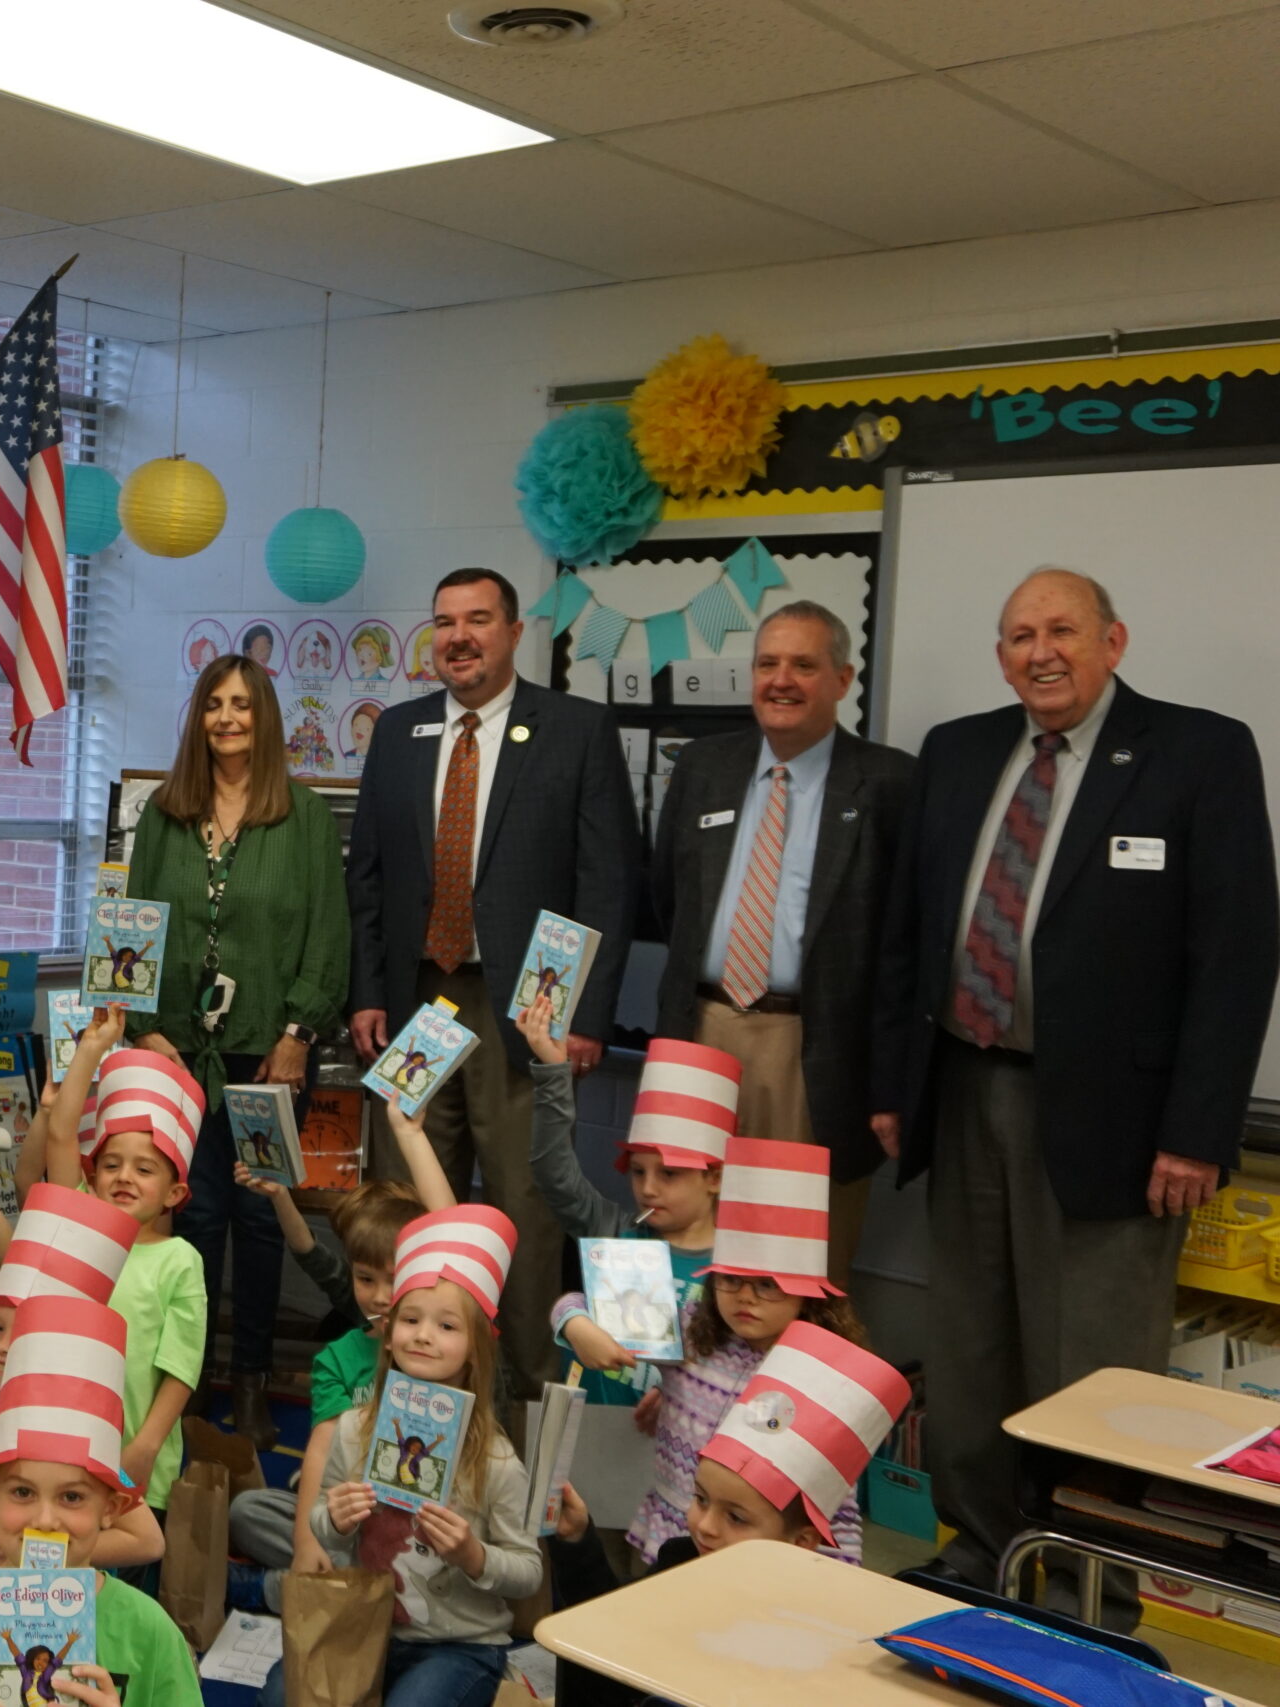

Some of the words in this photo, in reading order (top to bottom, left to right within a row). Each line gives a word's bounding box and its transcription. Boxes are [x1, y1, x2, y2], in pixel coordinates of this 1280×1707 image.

[971, 380, 1222, 442] 'Bee'
[364, 680, 376, 691] Alf
[625, 674, 638, 698] g
[686, 676, 700, 692] e
[730, 669, 735, 692] i
[284, 696, 337, 724] SUPERKIDS
[97, 903, 161, 931] CEO
[139, 914, 160, 922] Oliver
[539, 918, 580, 955] CEO
[311, 1100, 340, 1115] IME
[389, 1380, 455, 1423] CEO
[432, 1400, 454, 1415] Oliver
[14, 1587, 49, 1603] Edison
[52, 1588, 84, 1601] Oliver
[14, 1620, 56, 1630] Playground
[24, 1631, 63, 1639] Millionaire
